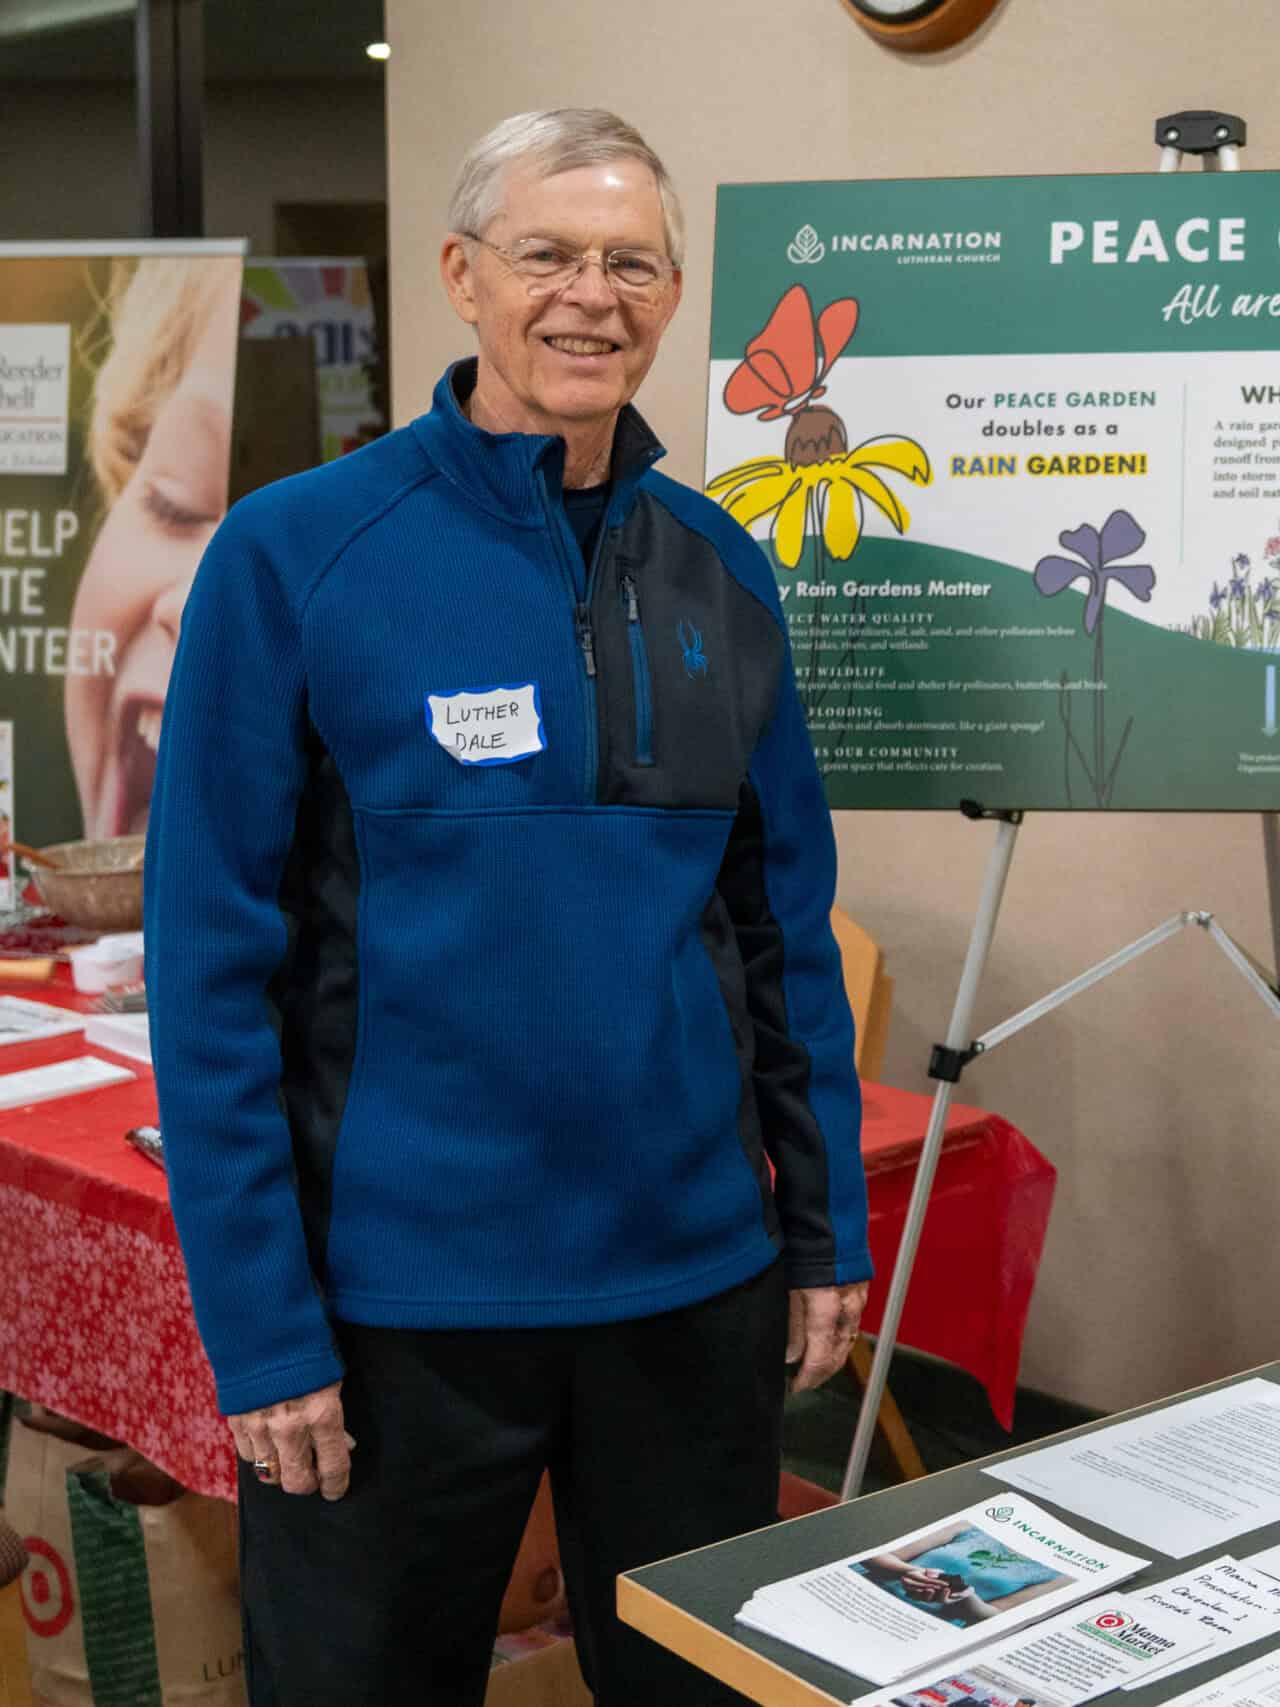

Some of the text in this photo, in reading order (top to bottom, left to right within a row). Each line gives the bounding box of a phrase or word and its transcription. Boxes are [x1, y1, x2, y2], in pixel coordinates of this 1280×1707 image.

[832, 231, 1002, 252] INCARNATION
[1049, 218, 1246, 265] PEACE
[896, 252, 1002, 265] LUTHERAN CHURCH
[1161, 283, 1222, 325] All
[946, 390, 1157, 410] Our PEACE GARDEN
[982, 418, 1119, 438] doubles as a
[1215, 419, 1224, 430] A
[1229, 419, 1254, 430] rain
[1213, 436, 1267, 450] designed
[951, 454, 1148, 476] RAIN GARDEN!
[1213, 453, 1253, 464] runoff
[1213, 470, 1238, 481] into
[1241, 470, 1277, 481] storm
[1213, 487, 1235, 499] and
[1238, 487, 1260, 499] soil
[0, 509, 80, 557] ELP
[796, 580, 837, 598] Rain
[842, 579, 923, 598] Gardens
[927, 579, 992, 597] Matter
[820, 612, 935, 625] WATER QUALITY
[818, 666, 886, 677] WILDLIFE
[446, 701, 521, 726] LUTHER
[455, 731, 507, 752] DALE
[834, 747, 959, 758] OUR COMMUNITY
[1011, 1519, 1110, 1573] INCARNATION
[1117, 1629, 1165, 1655] Market
[1130, 1623, 1176, 1649] Manna
